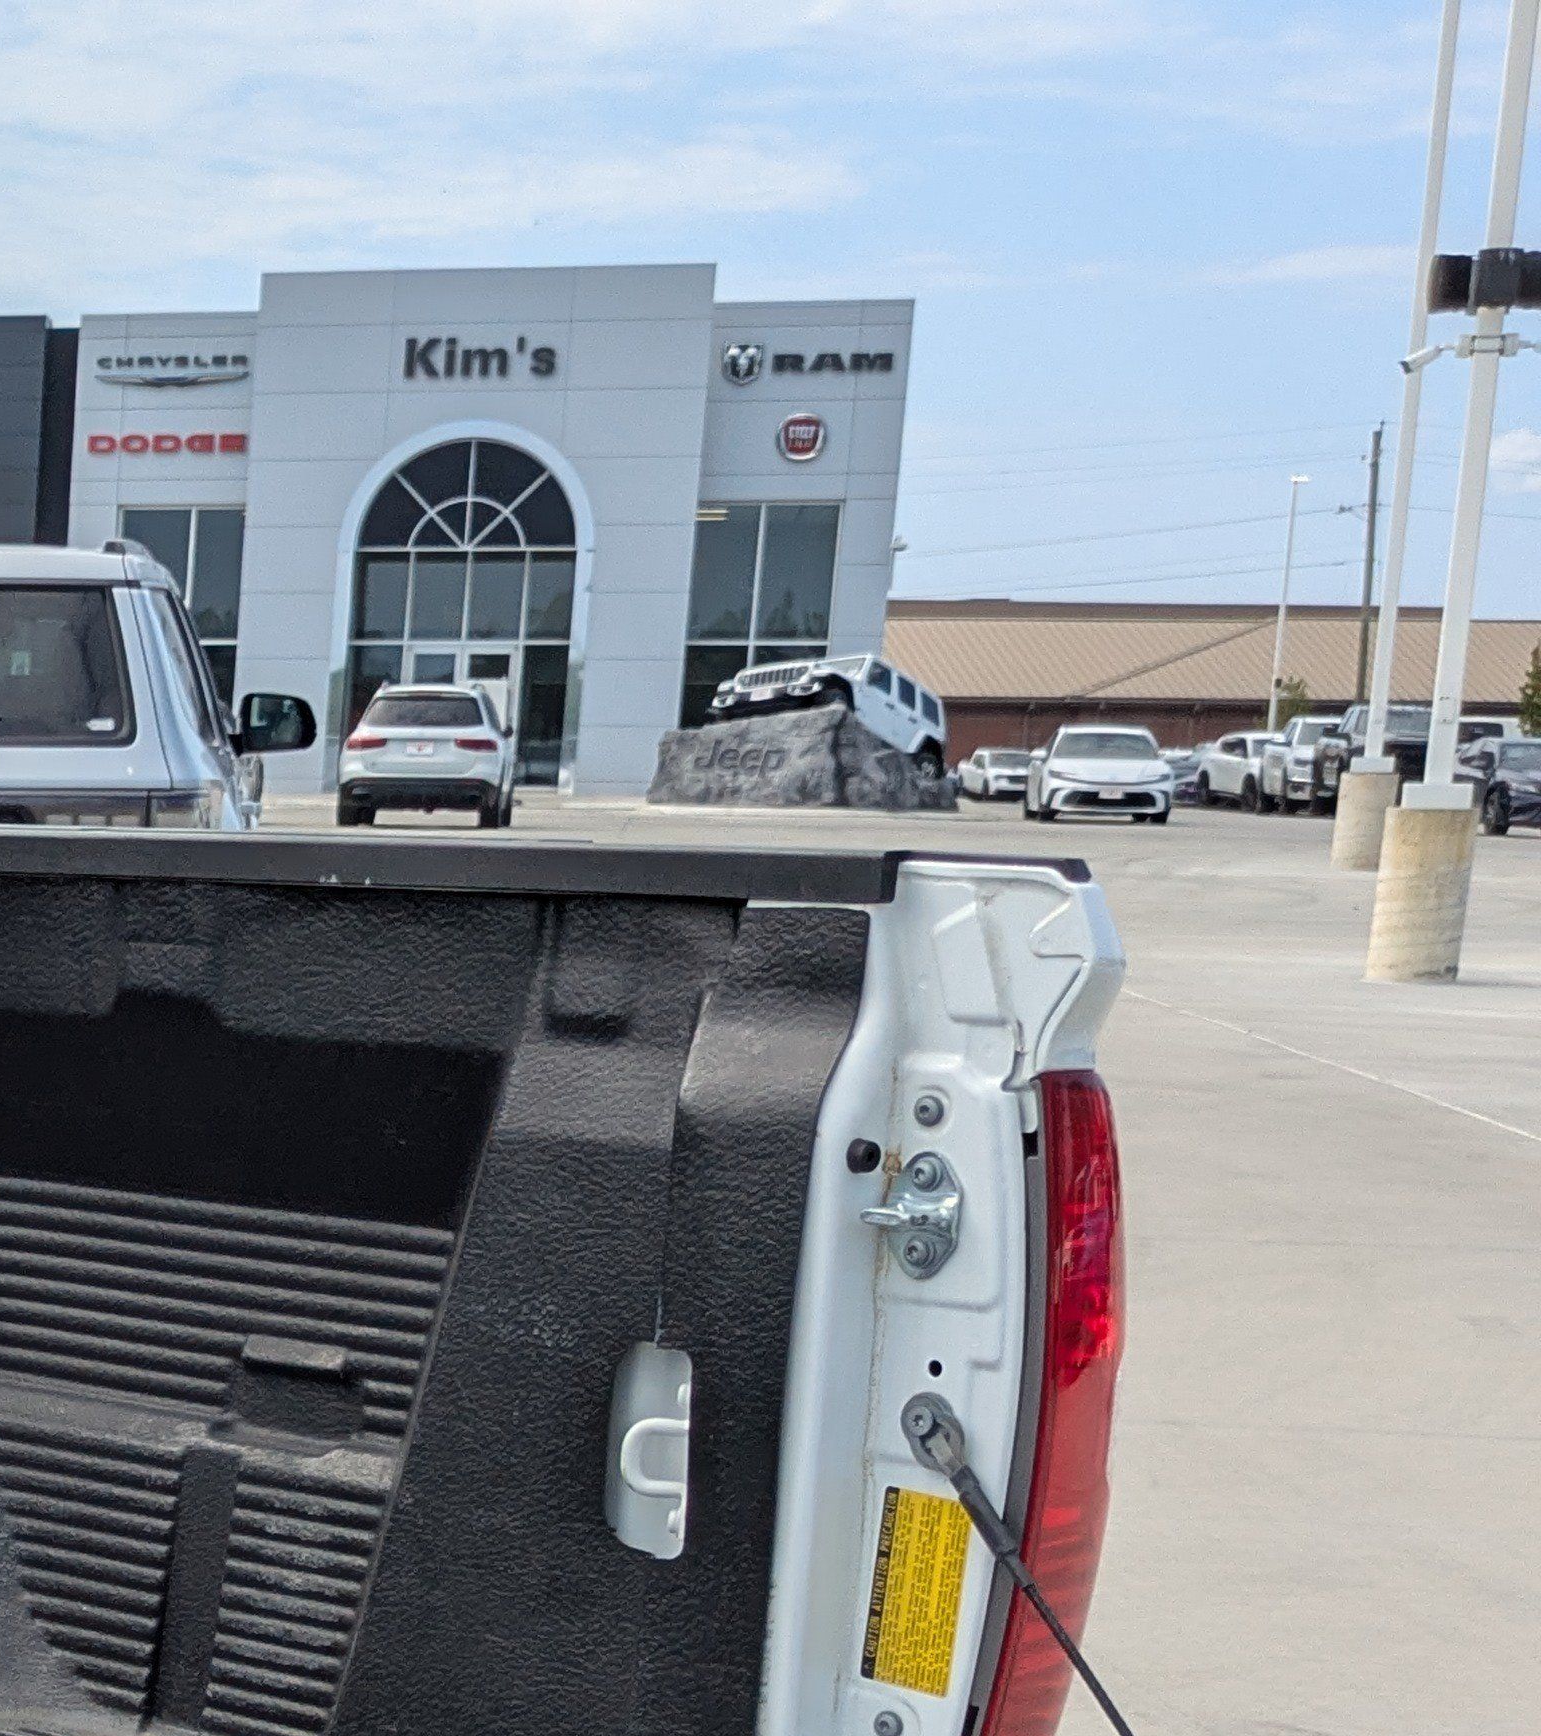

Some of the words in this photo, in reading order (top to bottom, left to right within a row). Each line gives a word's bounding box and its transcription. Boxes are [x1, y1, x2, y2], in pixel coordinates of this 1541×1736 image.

[97, 355, 248, 369] CHRYSLER
[404, 336, 557, 379] Kim's
[772, 353, 894, 372] RAM
[87, 433, 249, 454] DODGE
